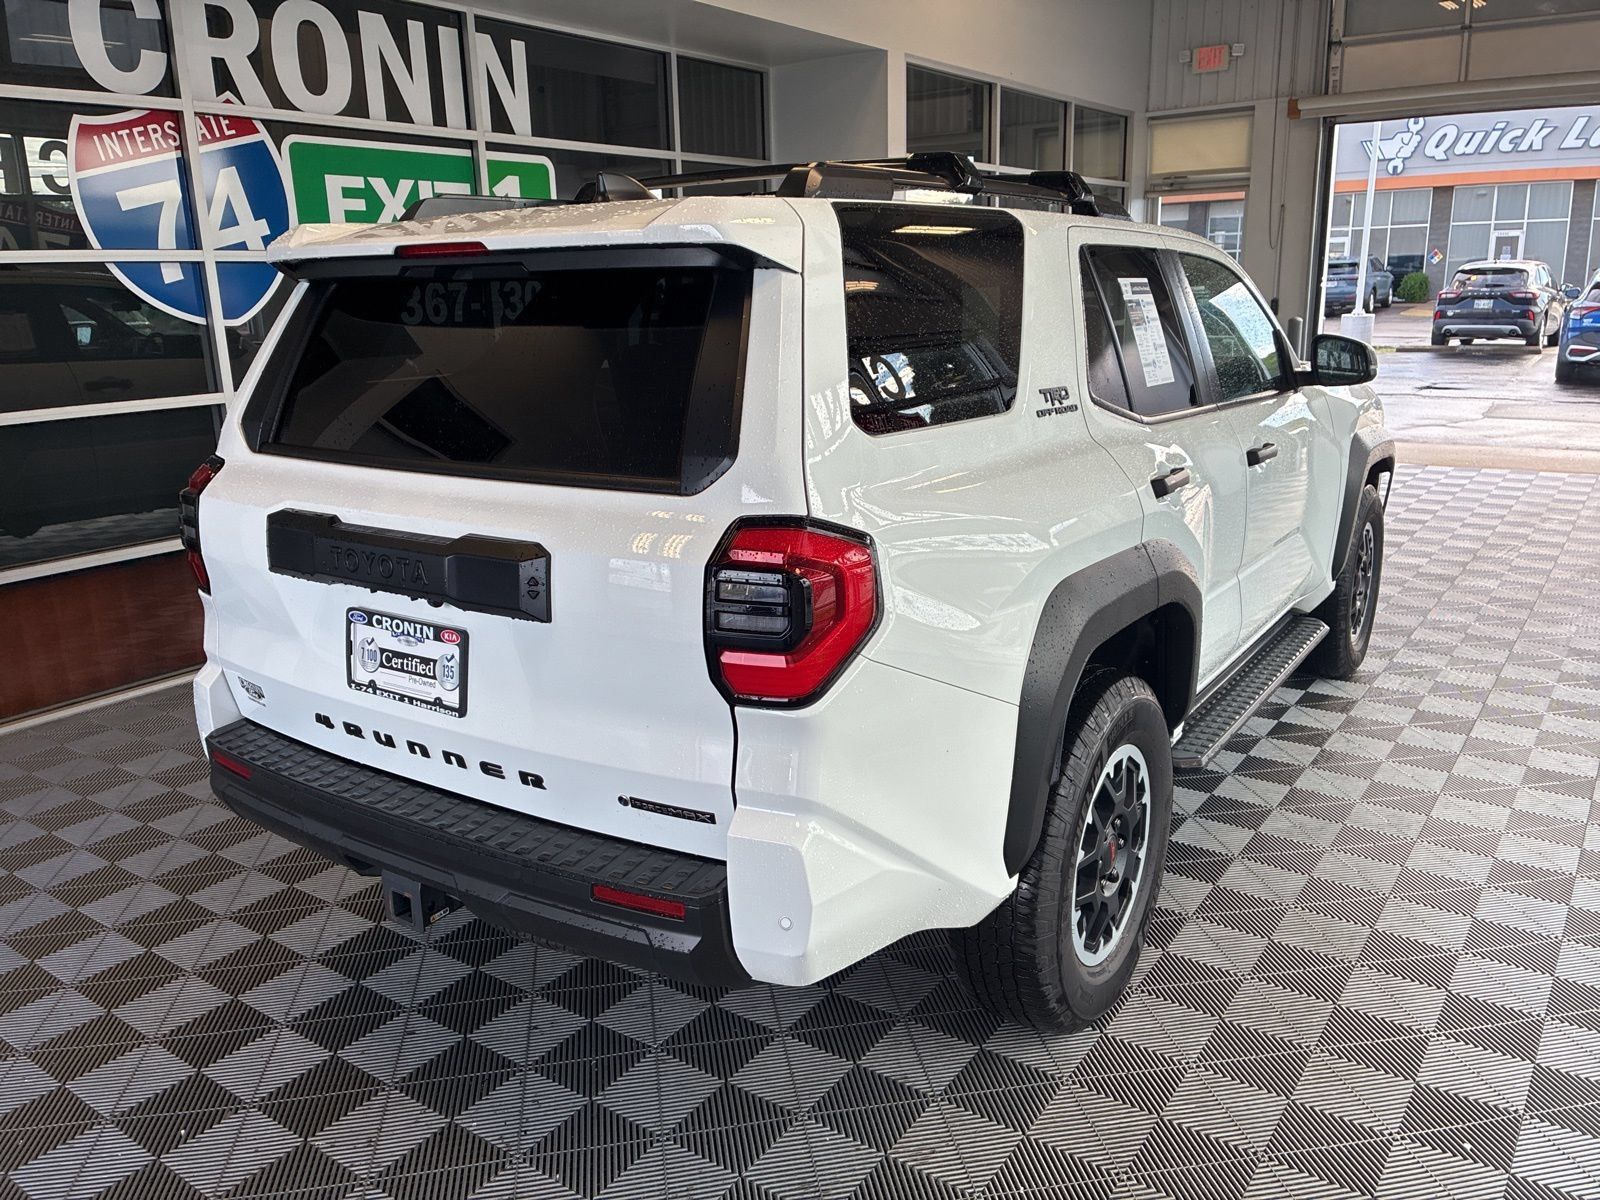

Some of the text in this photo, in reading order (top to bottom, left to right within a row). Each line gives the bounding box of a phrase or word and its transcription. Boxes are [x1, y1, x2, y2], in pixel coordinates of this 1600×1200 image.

[68, 0, 532, 137] CRONIN
[1424, 119, 1556, 161] Quick
[115, 165, 270, 283] 74
[1038, 386, 1070, 406] TRD
[330, 545, 428, 585] TOYOTA
[372, 615, 434, 640] CRONIN
[382, 652, 434, 676] Certified
[442, 664, 455, 680] 135
[376, 690, 400, 701] EXIT
[413, 699, 459, 717] Harrison
[315, 712, 547, 790] 4RUNNER
